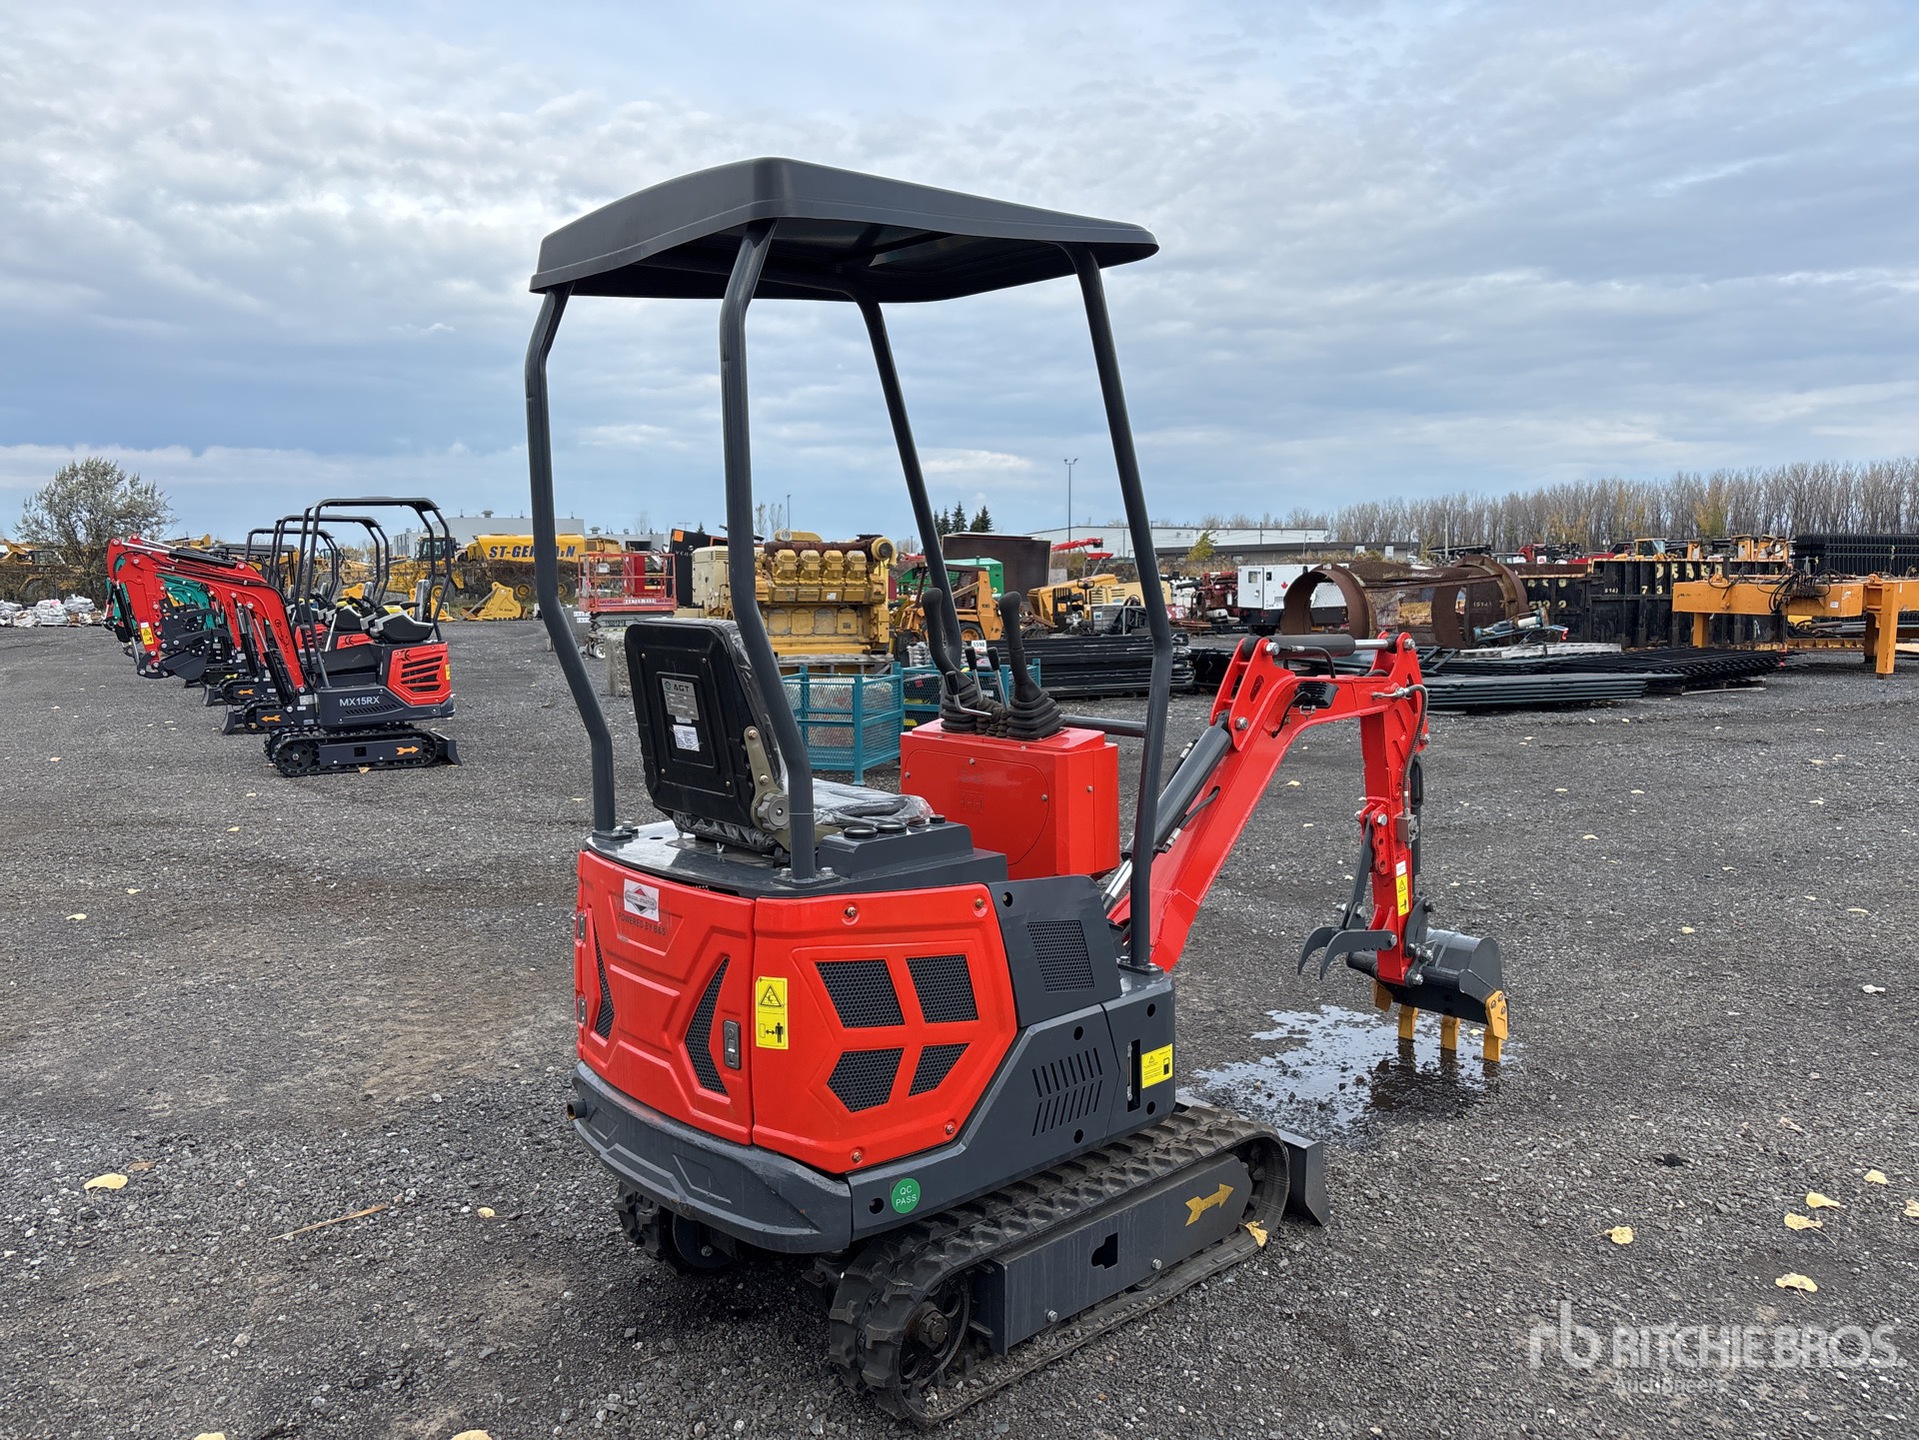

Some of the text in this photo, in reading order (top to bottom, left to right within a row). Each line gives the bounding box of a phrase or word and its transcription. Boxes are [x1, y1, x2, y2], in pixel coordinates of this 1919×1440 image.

[674, 683, 690, 692] AGT
[339, 696, 380, 707] MX15RX
[899, 1185, 913, 1196] QC
[895, 1193, 918, 1207] PASS
